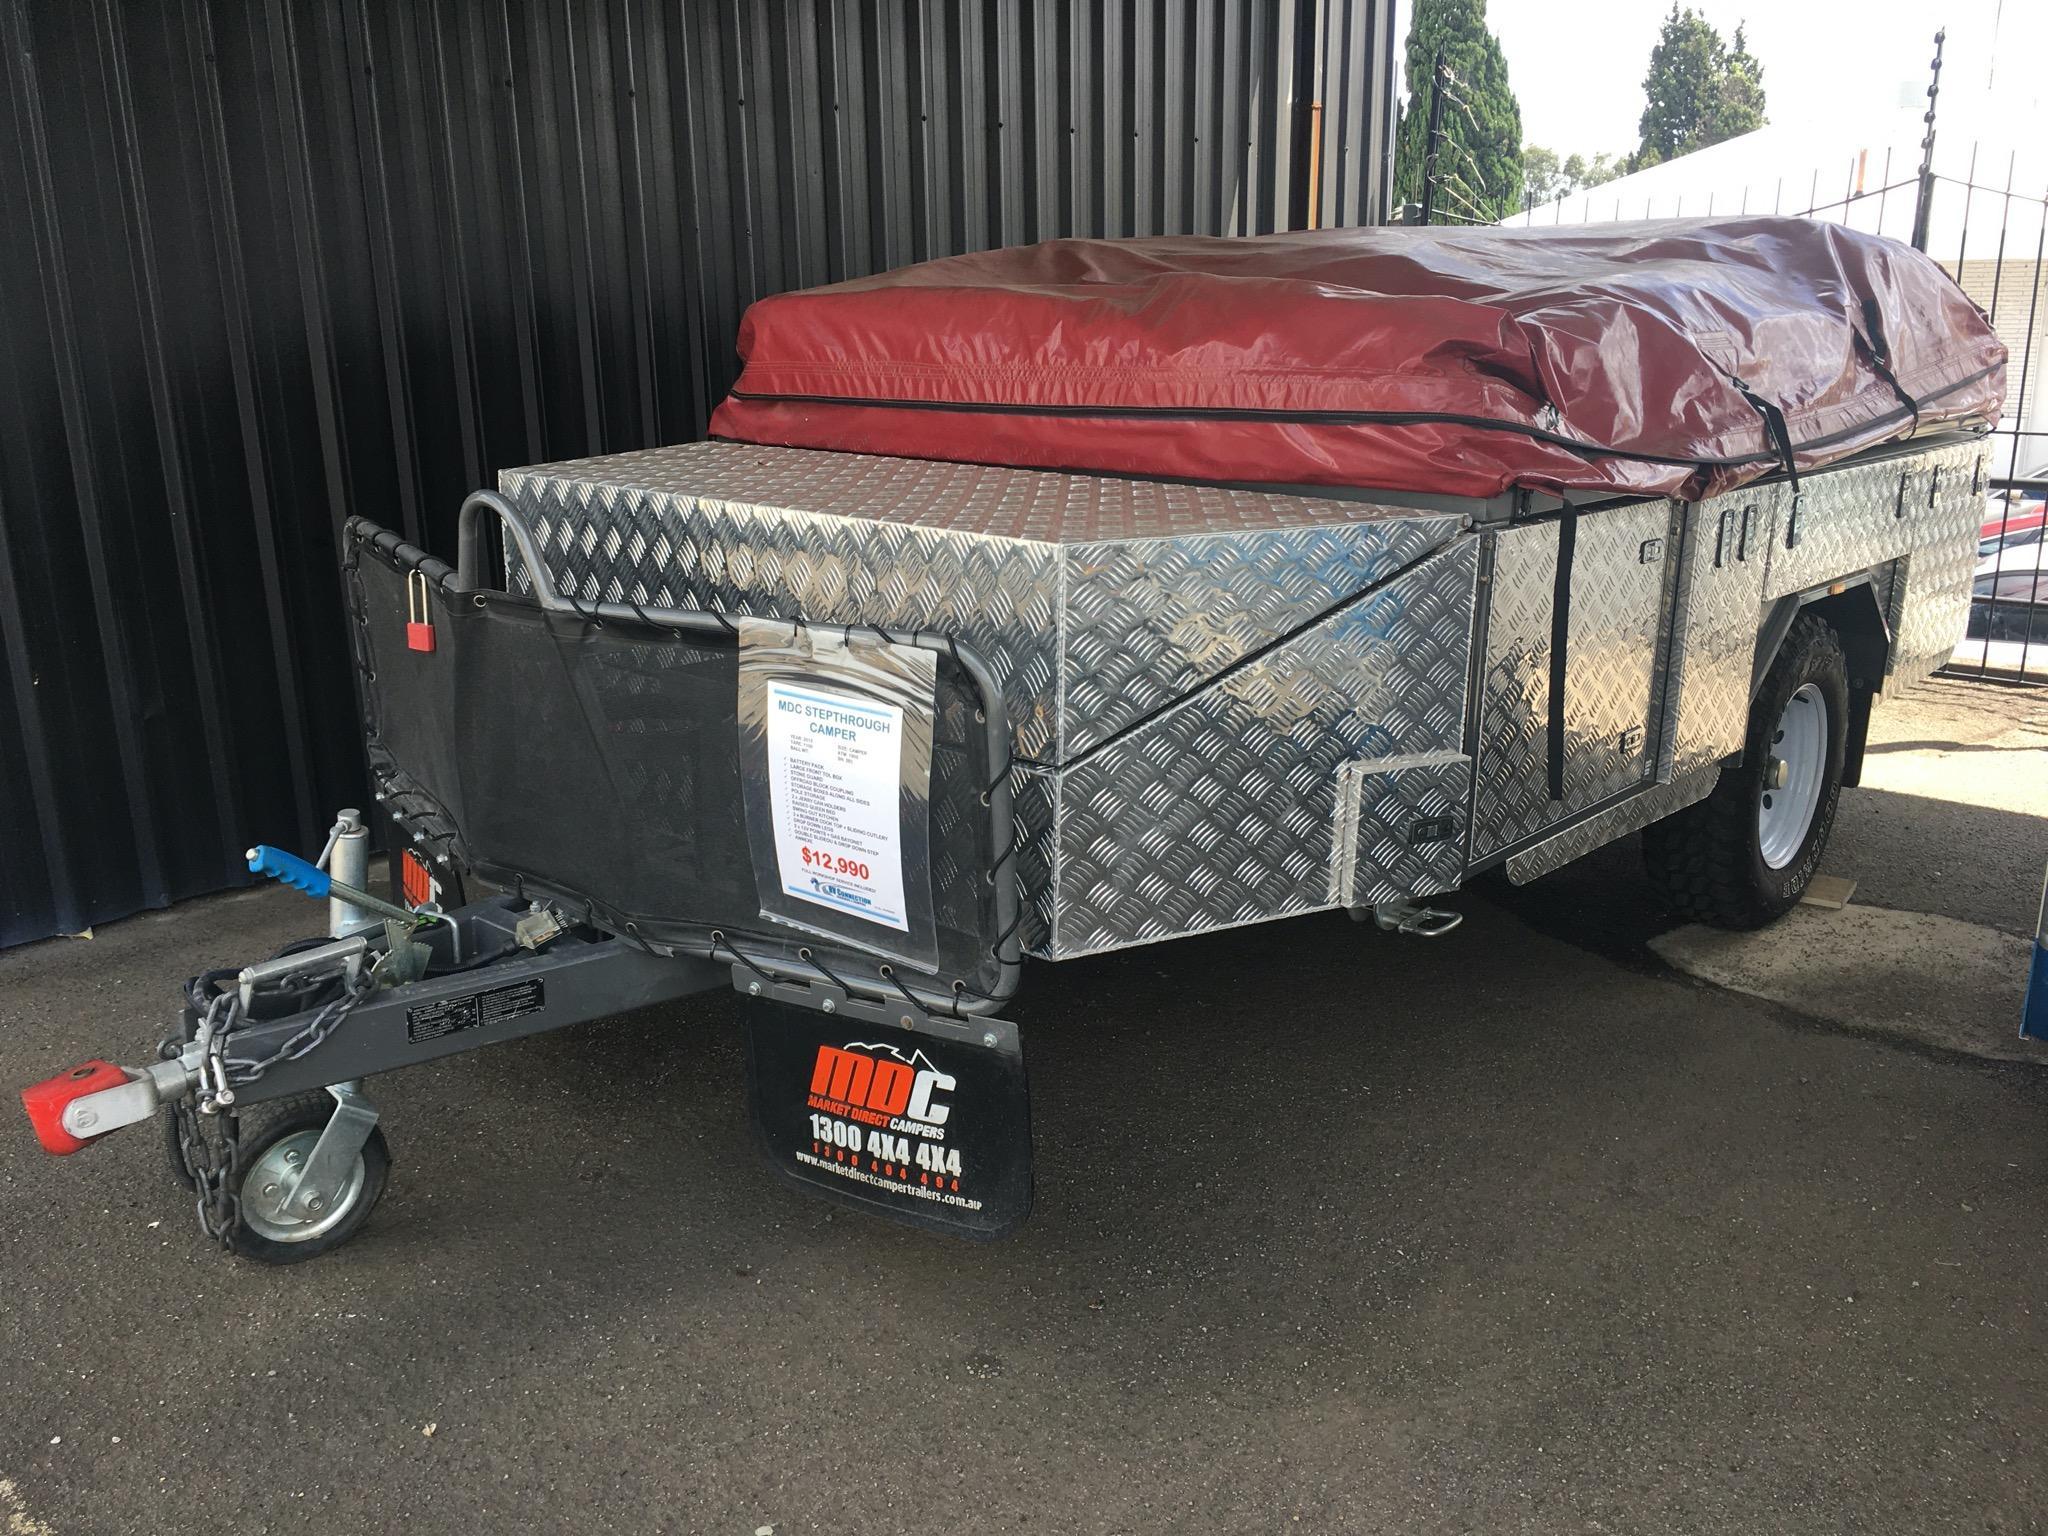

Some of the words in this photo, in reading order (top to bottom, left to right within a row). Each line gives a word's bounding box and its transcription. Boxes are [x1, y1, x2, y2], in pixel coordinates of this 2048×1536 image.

[779, 700, 802, 715] MDC
[805, 706, 890, 733] STEPTHROUGH
[809, 722, 856, 742] CAMPER
[790, 758, 810, 767] BATTERY
[790, 764, 805, 772] LARGE
[807, 768, 822, 776] FRONT
[791, 770, 805, 778] STONE
[807, 774, 823, 782] GUARD
[791, 776, 812, 786] OFFROAD
[830, 786, 854, 796] COUPLING
[791, 782, 812, 792] STORAGE
[813, 788, 828, 796] BOXES
[830, 792, 845, 800] ALONG
[805, 792, 825, 800] STORAGE
[824, 802, 846, 812] HOLDERS
[819, 813, 838, 822] KITCHEN
[795, 830, 813, 838] DOUBLE
[800, 814, 818, 822] BURNER
[848, 827, 866, 835] SLIDING
[868, 832, 888, 841] CUTLERY
[802, 846, 869, 880] $12,990
[837, 889, 871, 905] CONNECTION
[810, 1045, 956, 1125] MDC
[807, 1095, 850, 1117] MARKET
[850, 1107, 890, 1127] DIRECT
[890, 1118, 945, 1140] CAMPERS
[810, 1114, 861, 1152] 1300
[867, 1131, 910, 1166] 4X4
[916, 1143, 962, 1177] 4X4
